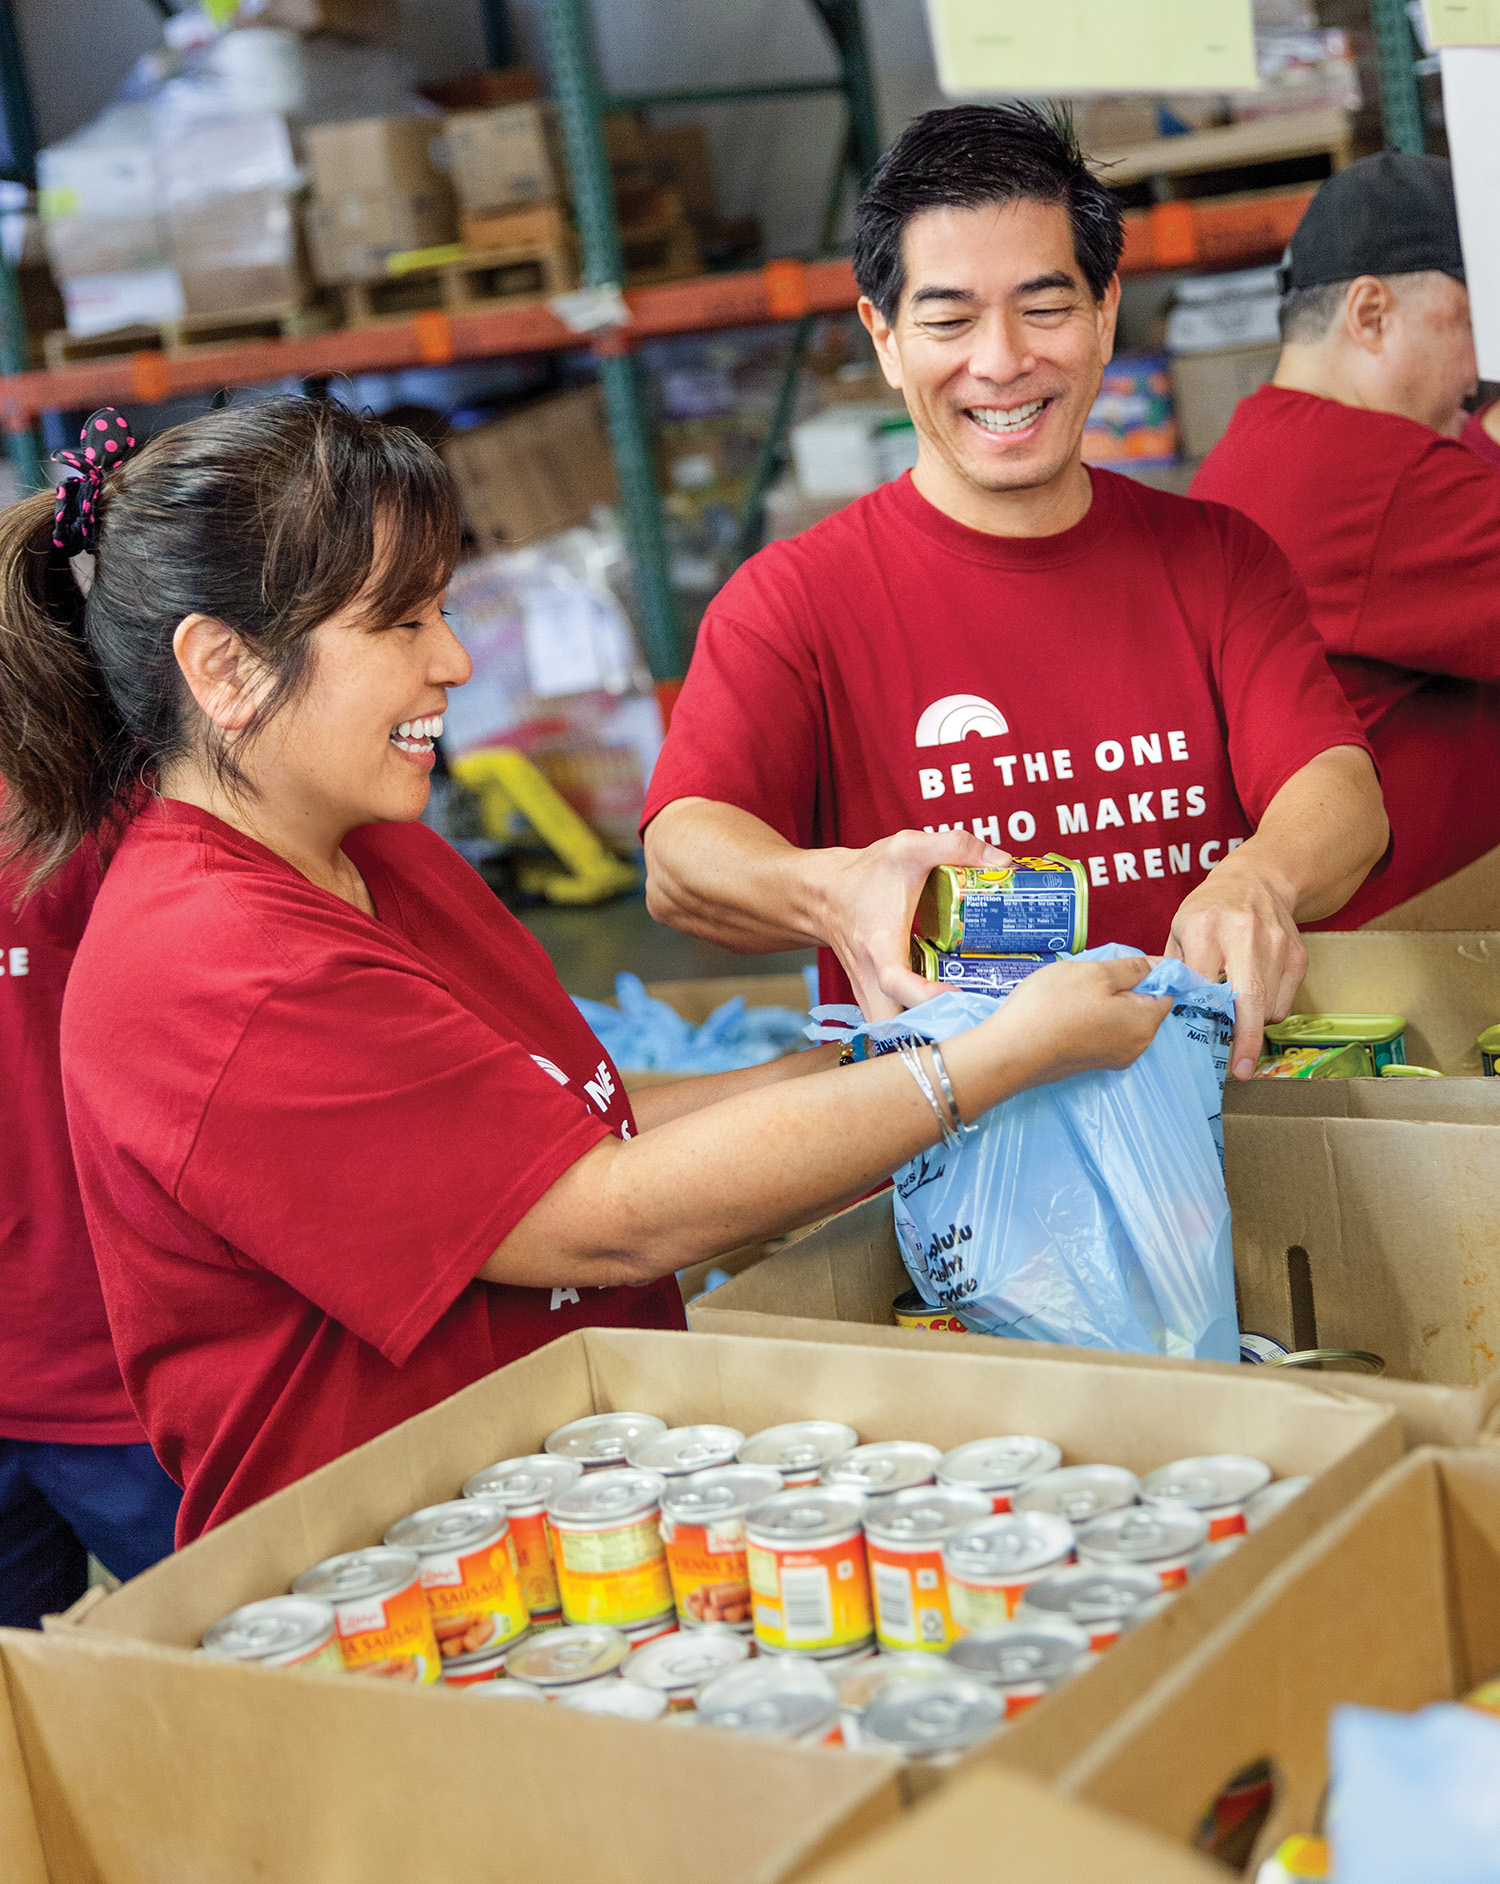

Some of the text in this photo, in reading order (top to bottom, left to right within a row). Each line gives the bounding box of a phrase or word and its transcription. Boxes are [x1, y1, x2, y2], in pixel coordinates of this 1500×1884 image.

[918, 730, 1190, 800] BE THE ONE
[1056, 785, 1207, 836] MAKES
[1072, 837, 1244, 888] ERENC
[583, 1060, 616, 1114] NE
